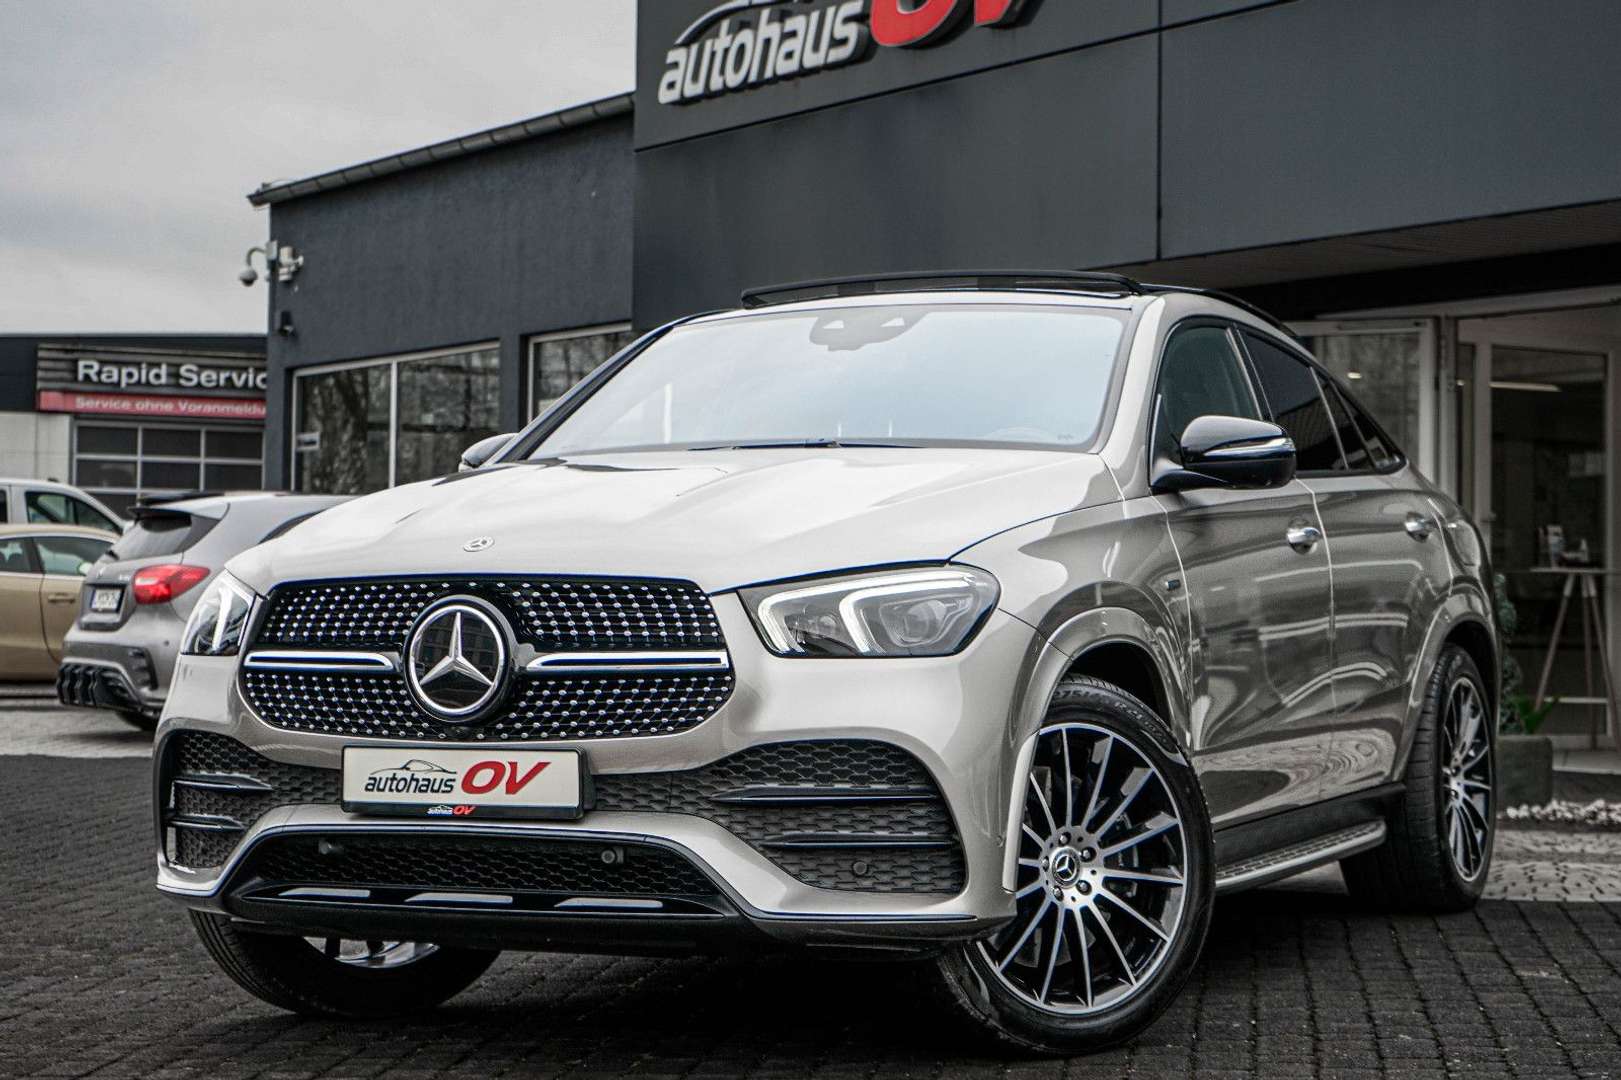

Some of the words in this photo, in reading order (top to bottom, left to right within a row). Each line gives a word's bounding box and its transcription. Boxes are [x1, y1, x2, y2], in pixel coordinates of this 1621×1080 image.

[658, 0, 864, 104] autohaus
[77, 360, 168, 388] Rapid
[75, 397, 132, 411] Service
[134, 400, 174, 413] ohne
[364, 773, 456, 793] autohaus
[461, 760, 552, 795] OV
[453, 805, 476, 815] OV
